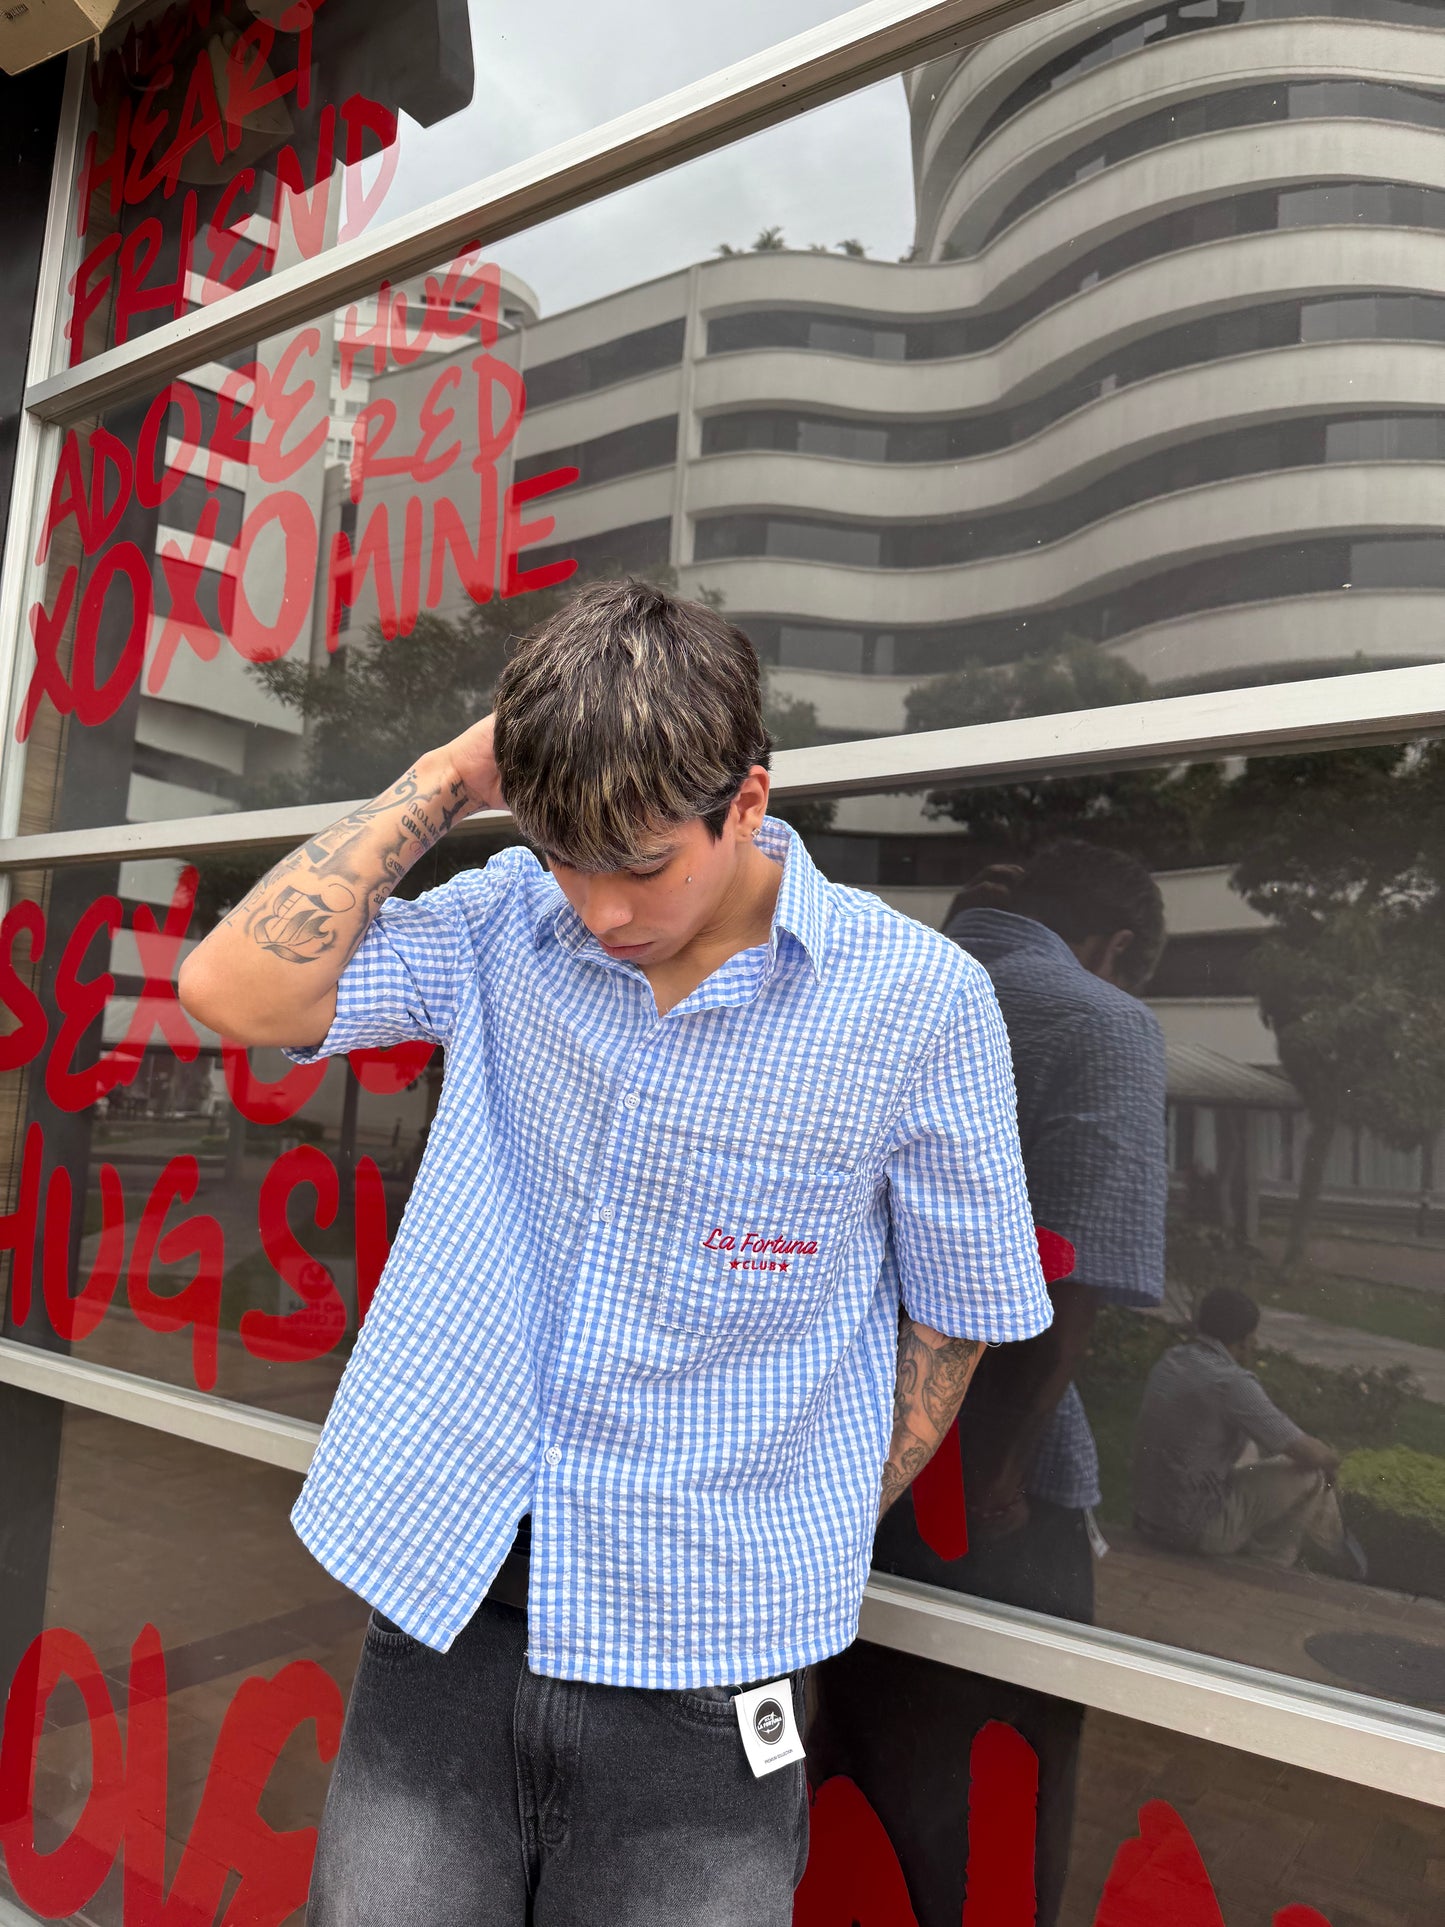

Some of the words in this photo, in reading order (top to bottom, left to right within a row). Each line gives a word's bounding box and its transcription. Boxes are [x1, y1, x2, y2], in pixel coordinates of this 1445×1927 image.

[77, 0, 326, 237] HEART
[65, 93, 400, 367] FRIEND
[339, 240, 501, 389] HUG
[36, 328, 330, 566] ADORE
[350, 354, 527, 503] RED
[16, 491, 318, 743] XOXO
[325, 458, 580, 652] MINE
[703, 1228, 735, 1250] La
[740, 1233, 818, 1255] Fortuna
[742, 1260, 777, 1271] CLUB
